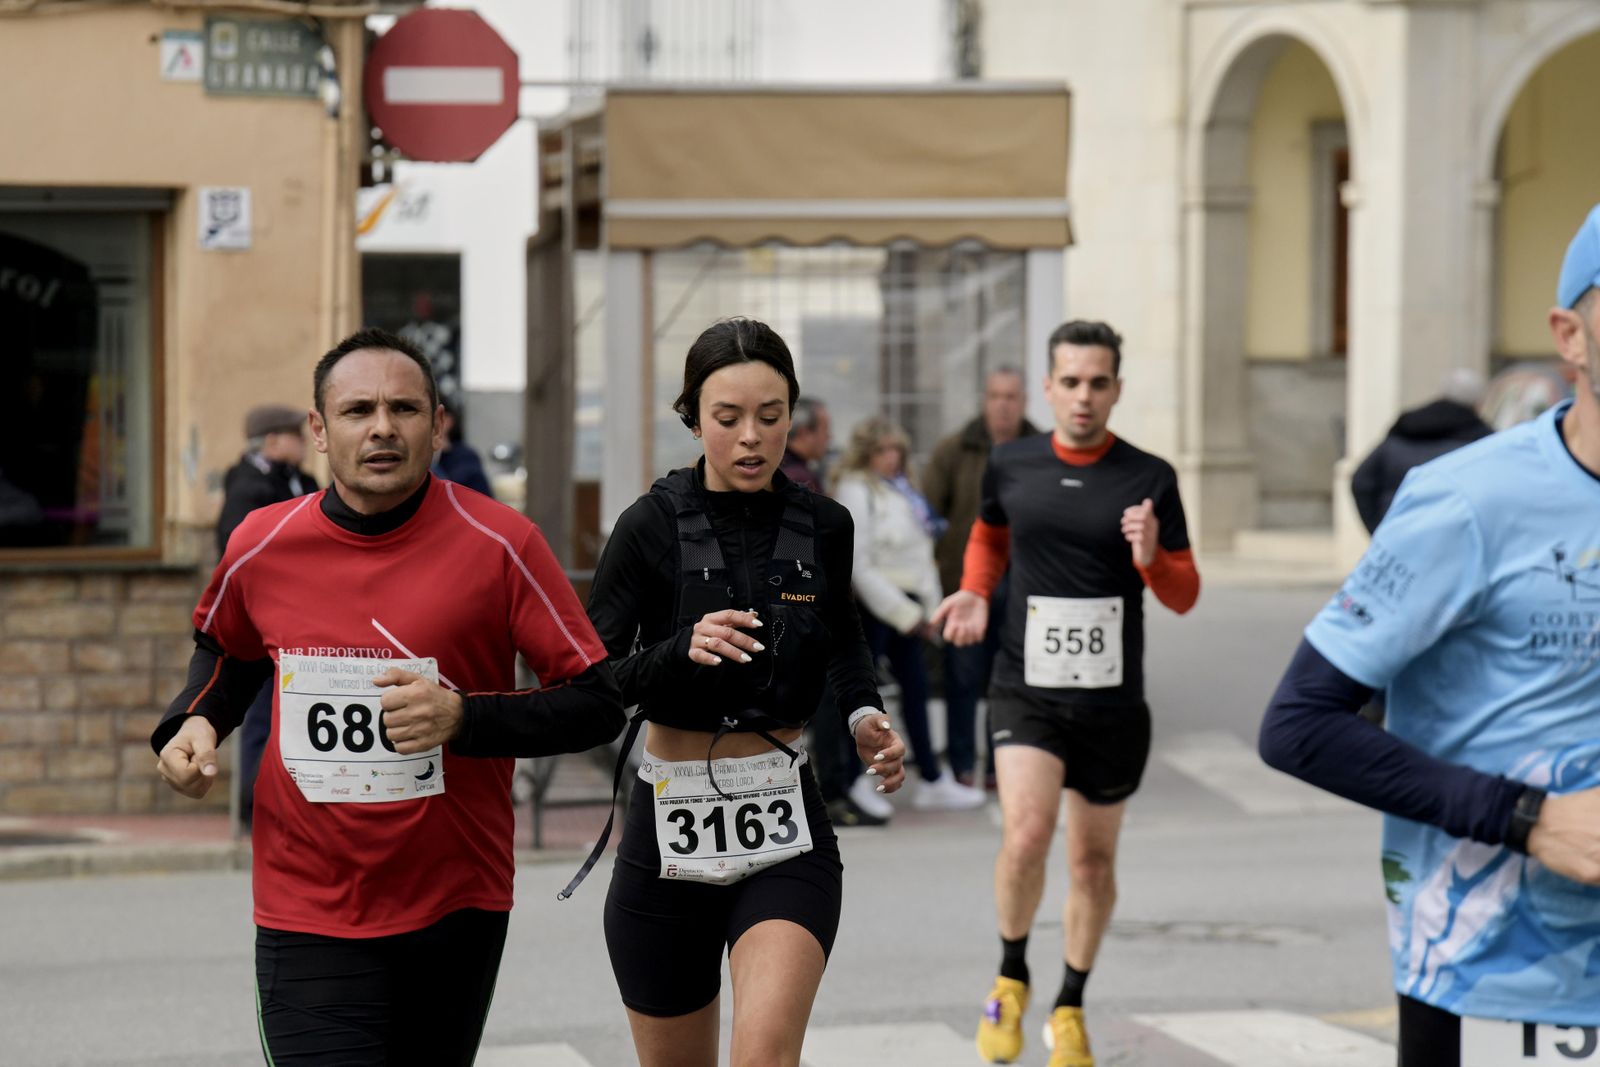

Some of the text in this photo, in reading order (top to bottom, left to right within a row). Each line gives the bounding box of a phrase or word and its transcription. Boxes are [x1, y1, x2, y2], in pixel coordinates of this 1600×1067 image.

[781, 592, 816, 602] EVADICT
[1045, 626, 1104, 655] 558
[308, 647, 392, 659] DEPORTIVO
[667, 799, 798, 855] 3163
